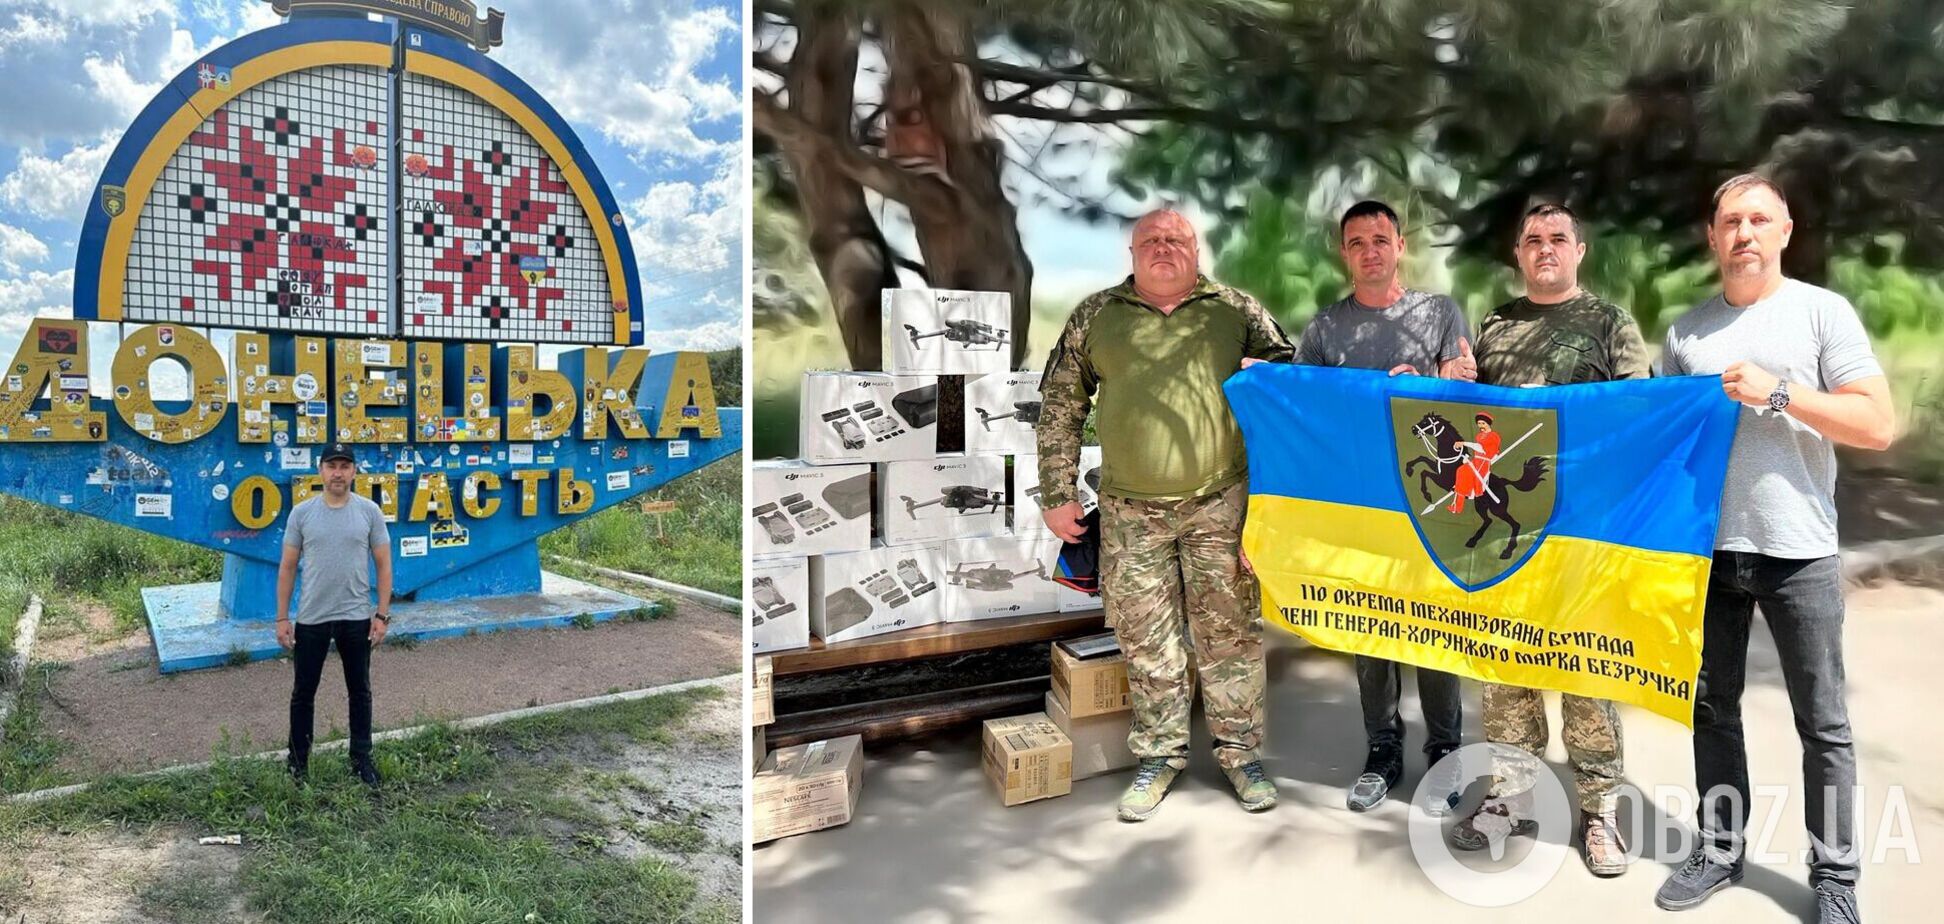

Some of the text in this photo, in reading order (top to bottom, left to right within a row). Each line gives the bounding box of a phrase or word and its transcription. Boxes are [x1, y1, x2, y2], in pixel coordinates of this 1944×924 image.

[424, 0, 470, 27] СПРАВОЮ
[0, 318, 722, 442] ДОНЕЦЬКА
[1301, 584, 1635, 658] 110 ОКРЕМА МЕХАНІЗОВАНА БРИГАДА
[1325, 611, 1509, 663] ГЕНЕРАЛ-ХОРУНЖОГО
[1515, 651, 1581, 672] МАРКА
[1587, 657, 1690, 700] БЕЗРУЧКА
